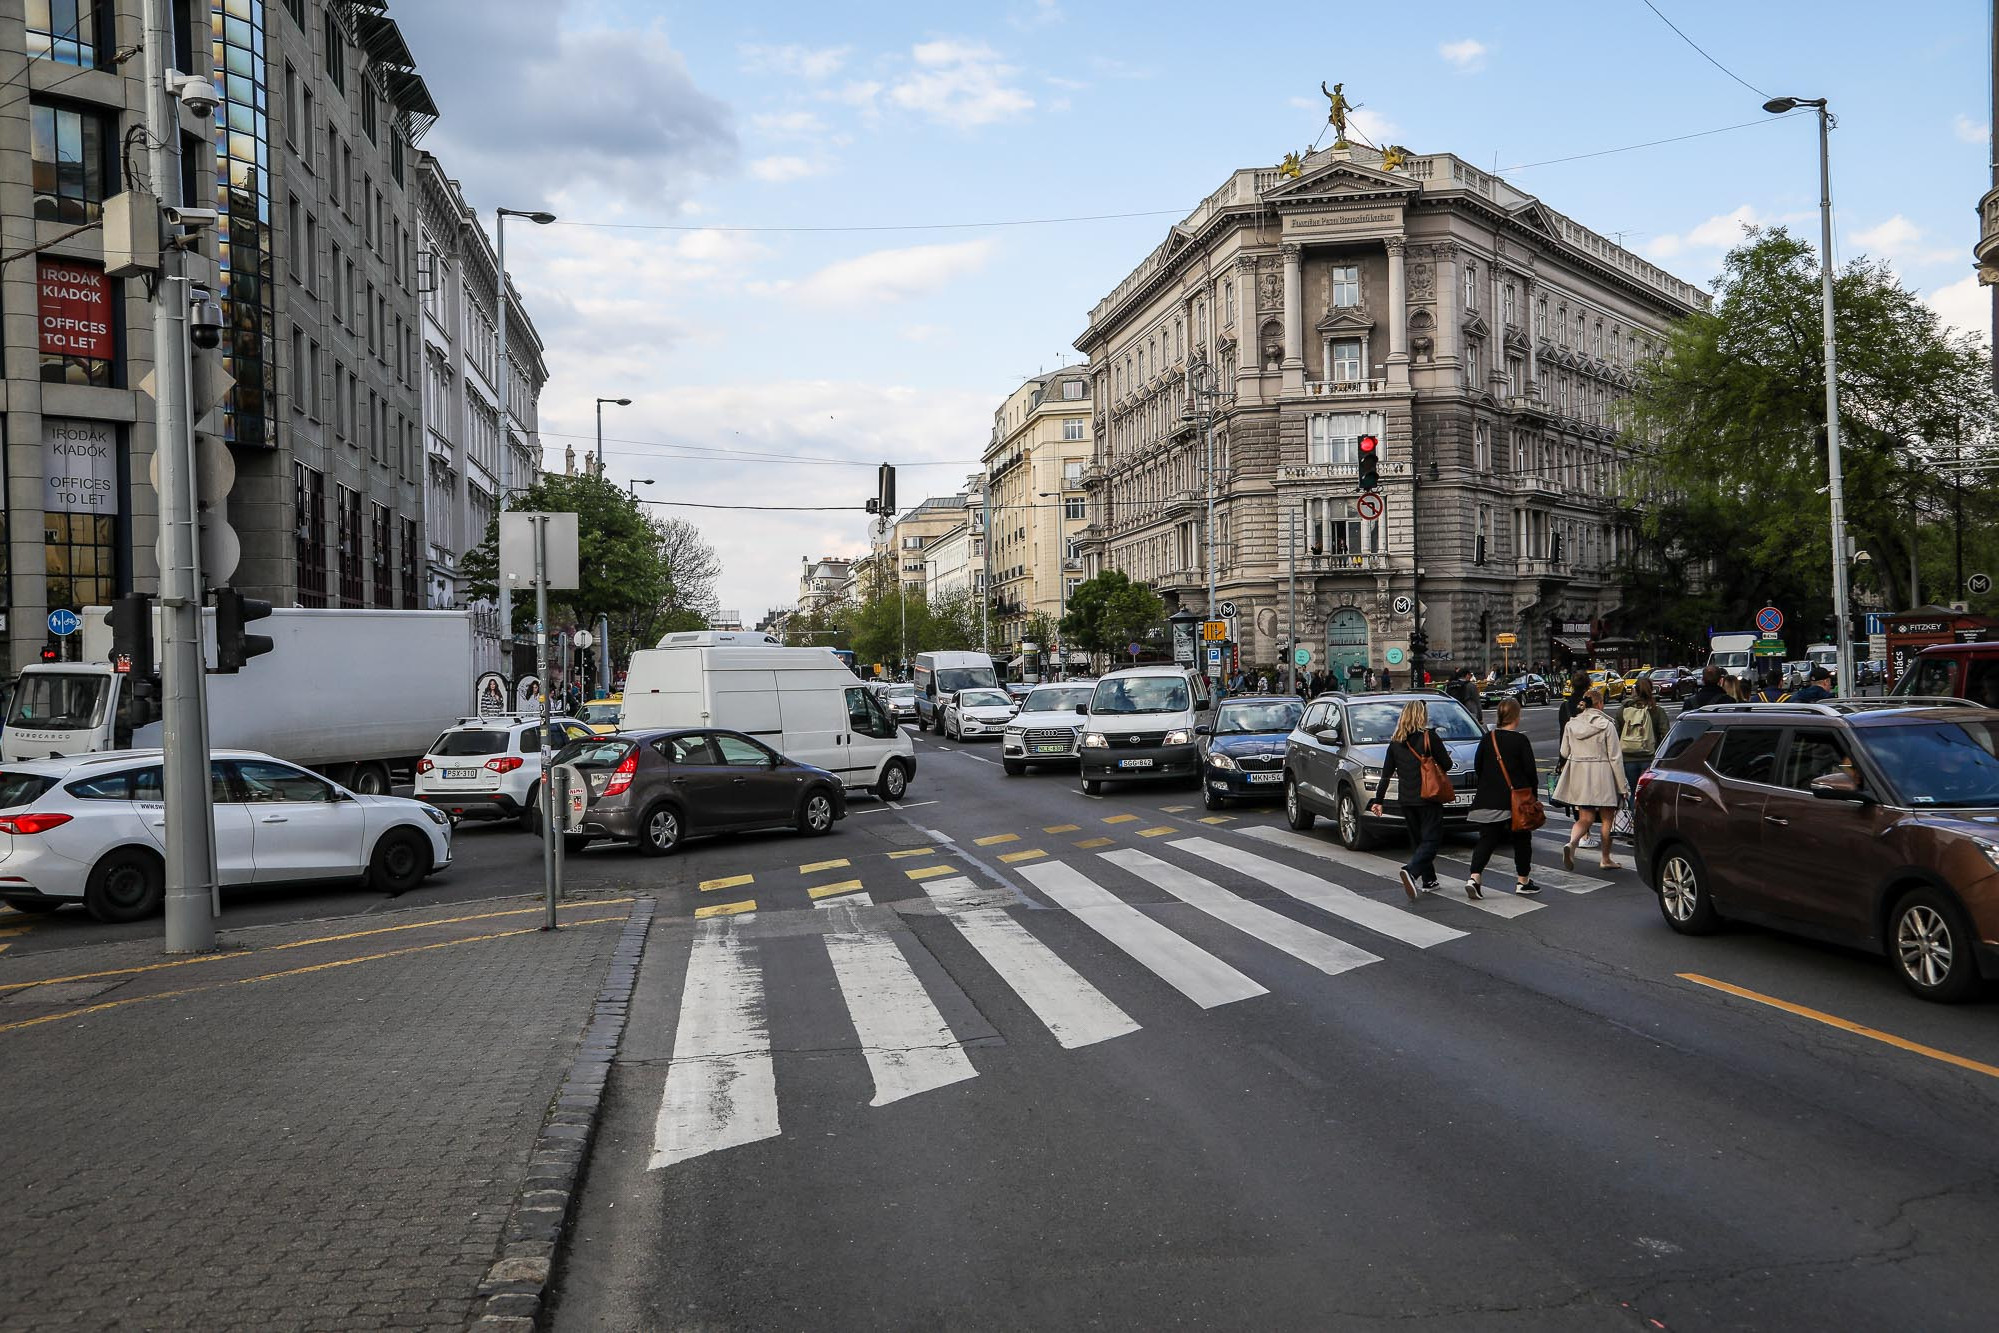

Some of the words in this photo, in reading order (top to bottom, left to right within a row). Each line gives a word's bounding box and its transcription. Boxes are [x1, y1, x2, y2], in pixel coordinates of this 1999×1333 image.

[42, 268, 100, 287] IRODÁK
[43, 285, 102, 304] KIADÓK
[43, 316, 107, 335] OFFICES
[43, 332, 66, 346] TO
[70, 335, 97, 350] LET
[50, 476, 111, 491] OFFICES
[56, 492, 77, 504] TO
[81, 493, 106, 505] LET
[1909, 623, 1942, 631] FITZKEY
[1210, 650, 1218, 659] P
[15, 731, 71, 740] EUROCARGO
[447, 770, 475, 778] PSX-310
[1252, 773, 1283, 781] MKN-54
